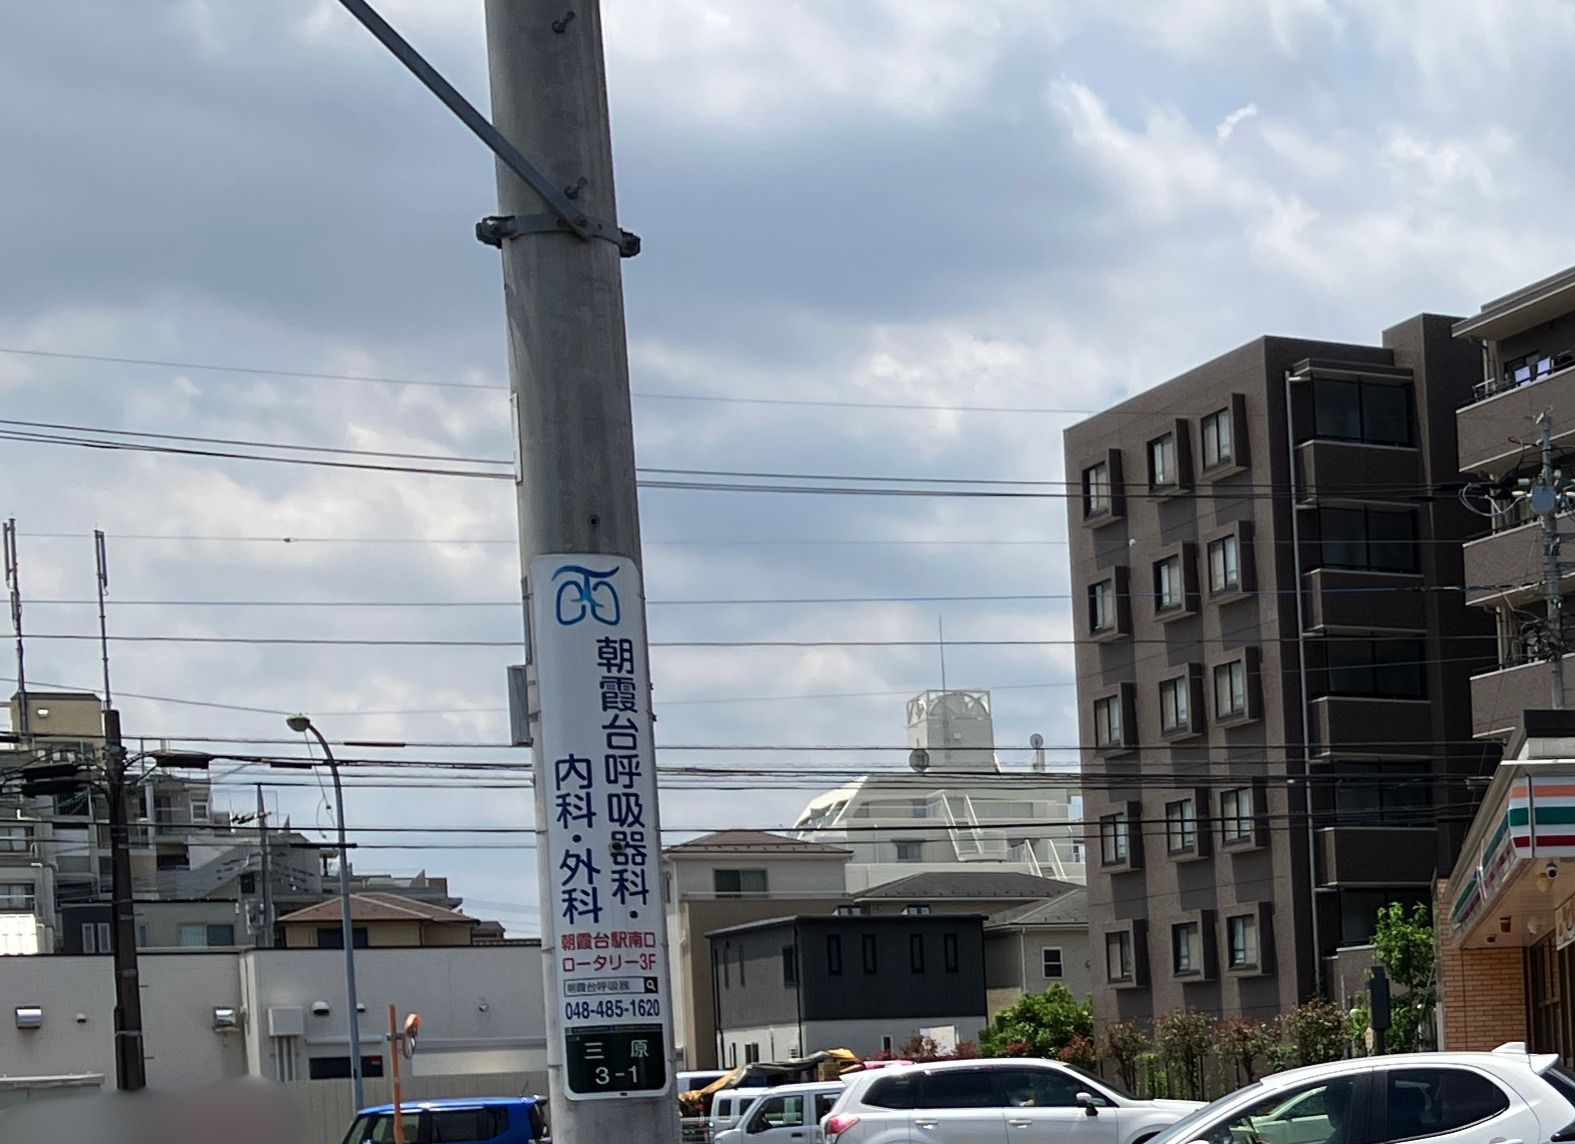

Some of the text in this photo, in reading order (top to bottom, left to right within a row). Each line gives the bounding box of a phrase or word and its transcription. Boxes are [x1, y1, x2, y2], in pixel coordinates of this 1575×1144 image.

[554, 753, 603, 925] 内科・外科
[561, 931, 656, 951] 朝霞台駅南口
[562, 953, 657, 973] ロータリー3F
[565, 998, 660, 1020] 048-485-1620
[595, 1066, 638, 1085] 3-1
